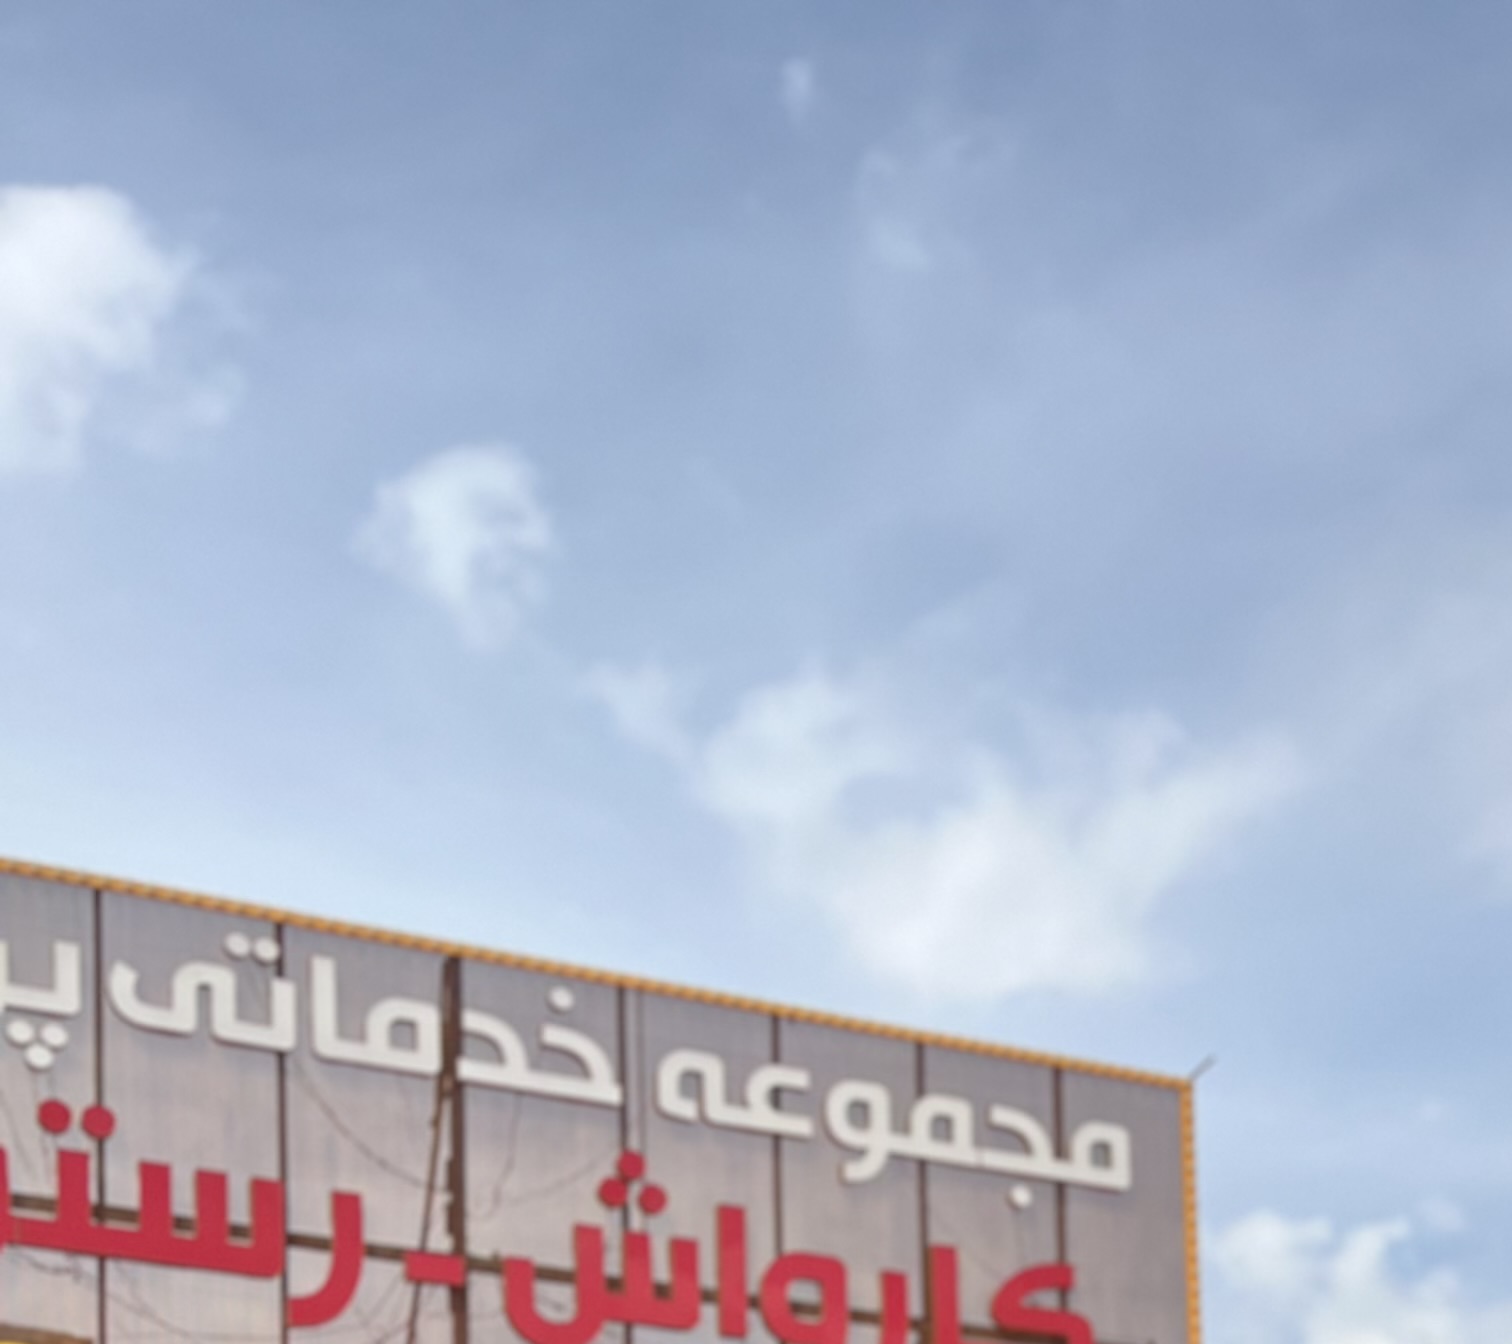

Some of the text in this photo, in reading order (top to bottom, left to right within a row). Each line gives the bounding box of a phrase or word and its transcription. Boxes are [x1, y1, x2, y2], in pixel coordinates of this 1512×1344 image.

[109, 931, 623, 1107] خدماتی
[0, 1097, 369, 1329] رست
[655, 1046, 1132, 1210] مجموعه
